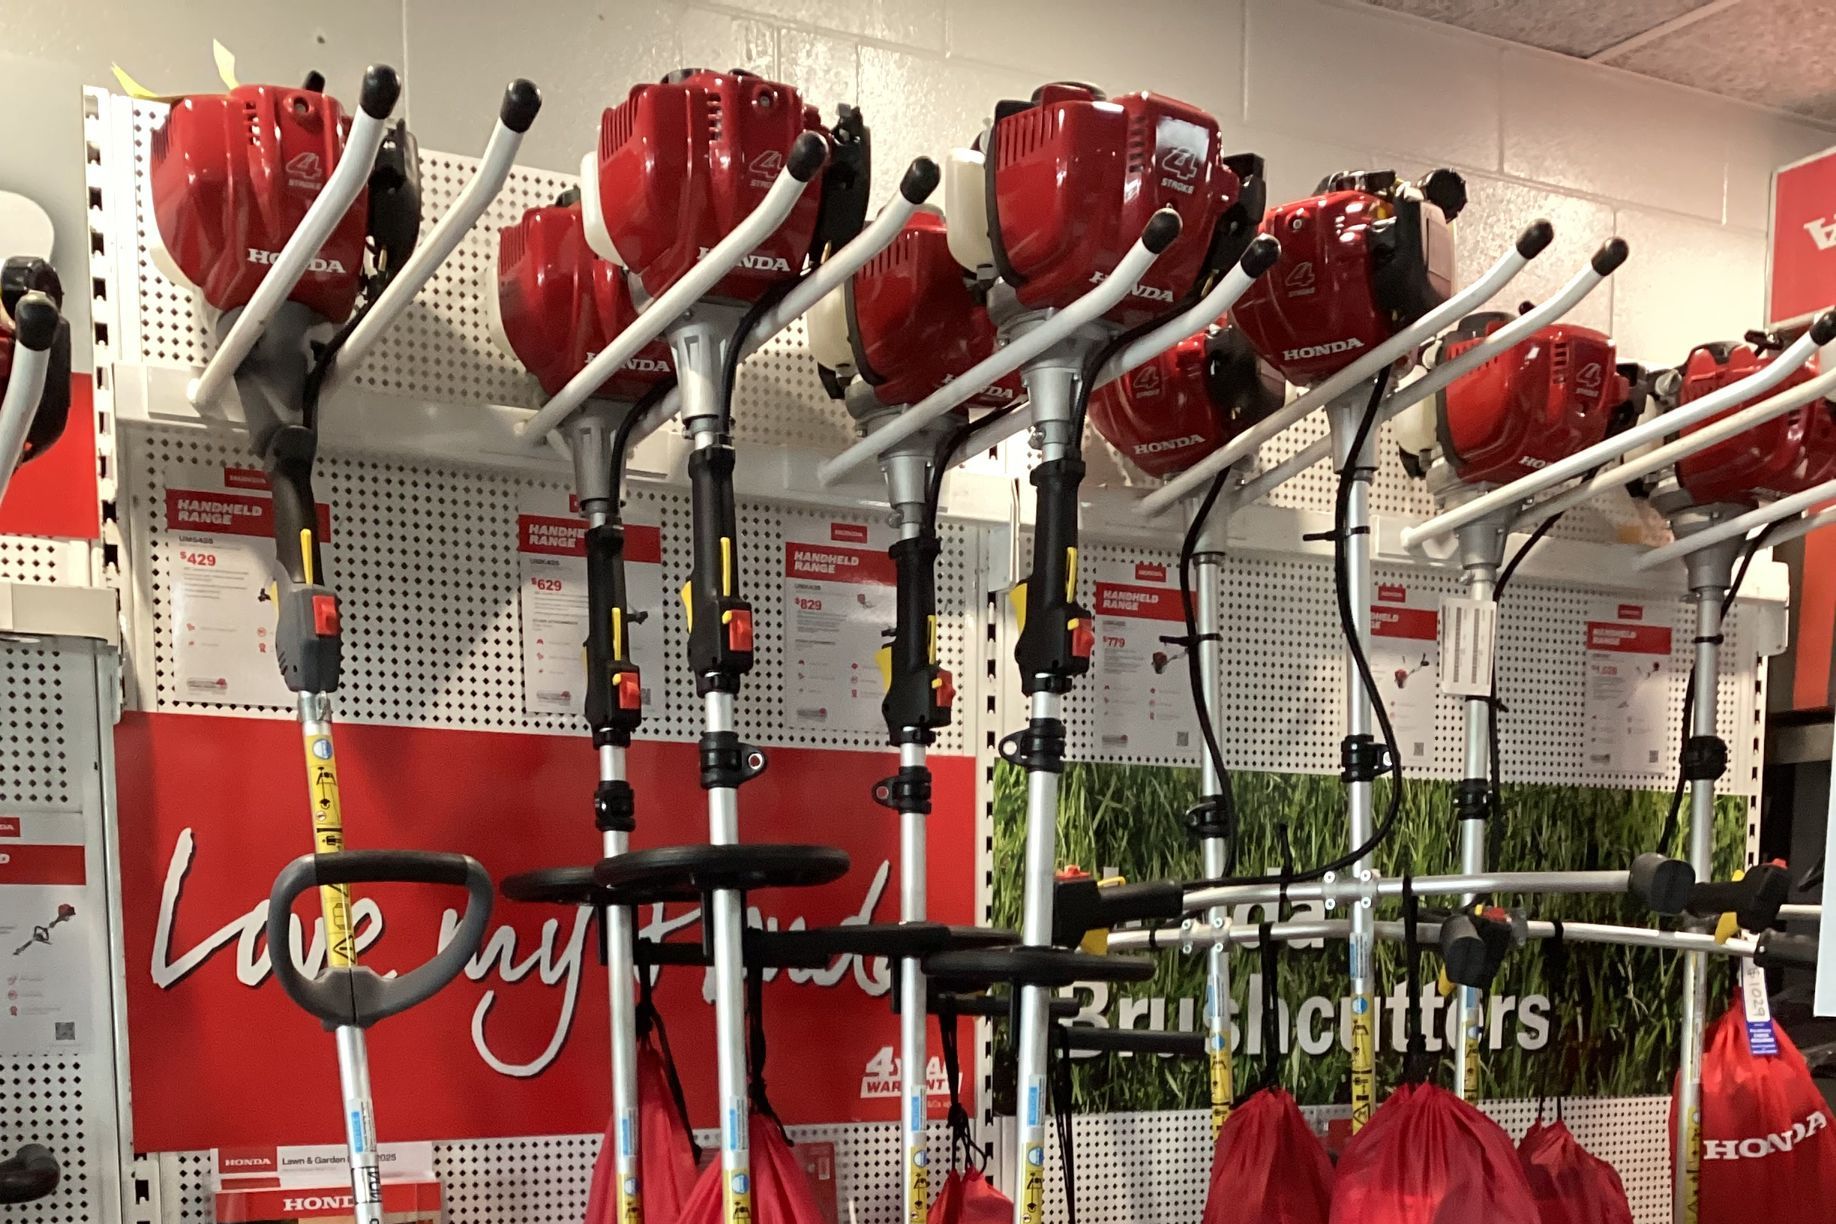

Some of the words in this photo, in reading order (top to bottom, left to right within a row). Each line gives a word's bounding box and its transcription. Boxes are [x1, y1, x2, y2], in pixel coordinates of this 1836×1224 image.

[1161, 147, 1197, 181] 4
[1161, 176, 1195, 194] STROKE
[247, 248, 346, 274] HODA
[697, 246, 790, 272] HNDA
[1089, 270, 1174, 303] HNDA
[1283, 337, 1365, 362] HONDA
[584, 352, 671, 373] HNDA
[1134, 434, 1206, 455] HONDA
[177, 498, 263, 517] HANDHELD
[178, 511, 232, 525] RANGE
[528, 523, 587, 539] HANDHE
[529, 535, 577, 548] RANGE
[180, 550, 217, 567] $429
[794, 551, 859, 567] HANDHELD
[794, 561, 836, 574] RANGE
[531, 577, 562, 592] $629
[795, 597, 822, 611] $829
[1103, 590, 1159, 604] HANDHELD
[1103, 600, 1139, 611] RANGE
[865, 1046, 895, 1082] 4
[1703, 1110, 1828, 1160] HONDA
[224, 1157, 272, 1167] HONDA
[281, 1157, 306, 1166] Lawn
[307, 1157, 313, 1165] &
[314, 1156, 346, 1165] Garden
[282, 1195, 355, 1212] HON
